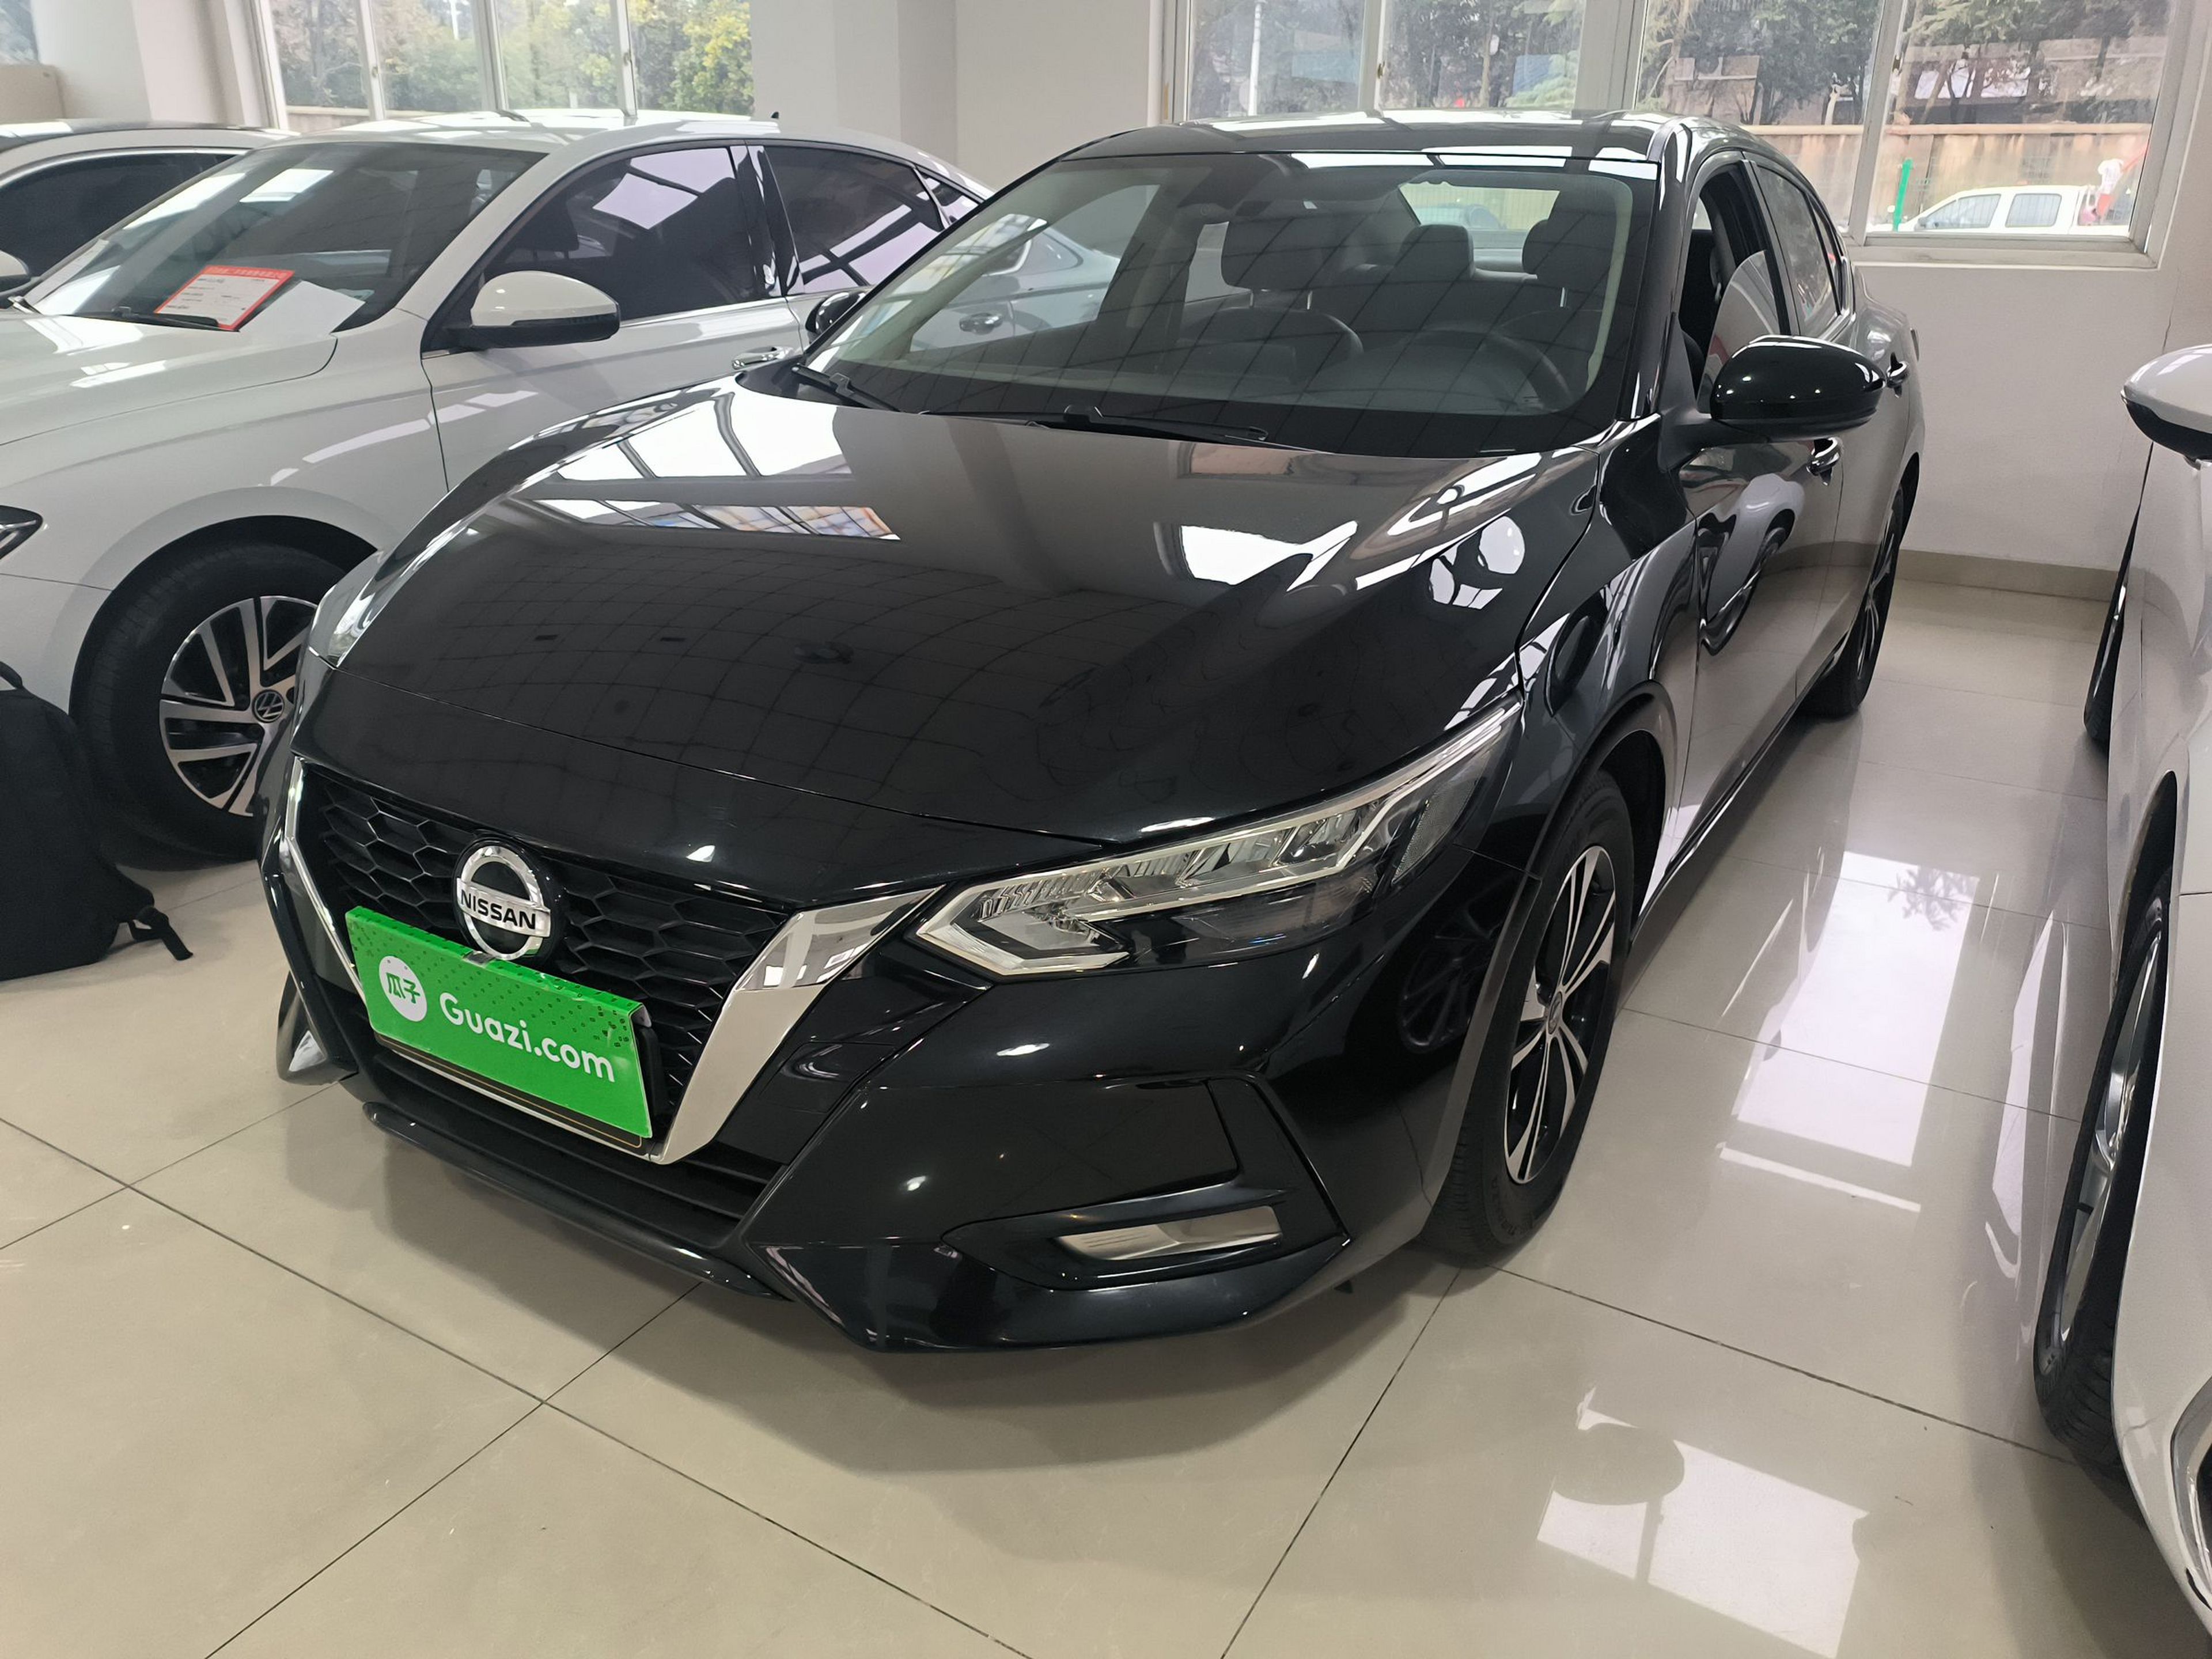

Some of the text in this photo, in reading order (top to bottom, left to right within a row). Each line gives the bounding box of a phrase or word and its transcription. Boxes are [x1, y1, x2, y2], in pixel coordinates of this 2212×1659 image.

[461, 889, 536, 929] NISSAN
[386, 972, 421, 1004] 瓜子
[440, 992, 615, 1082] Guazi.com
